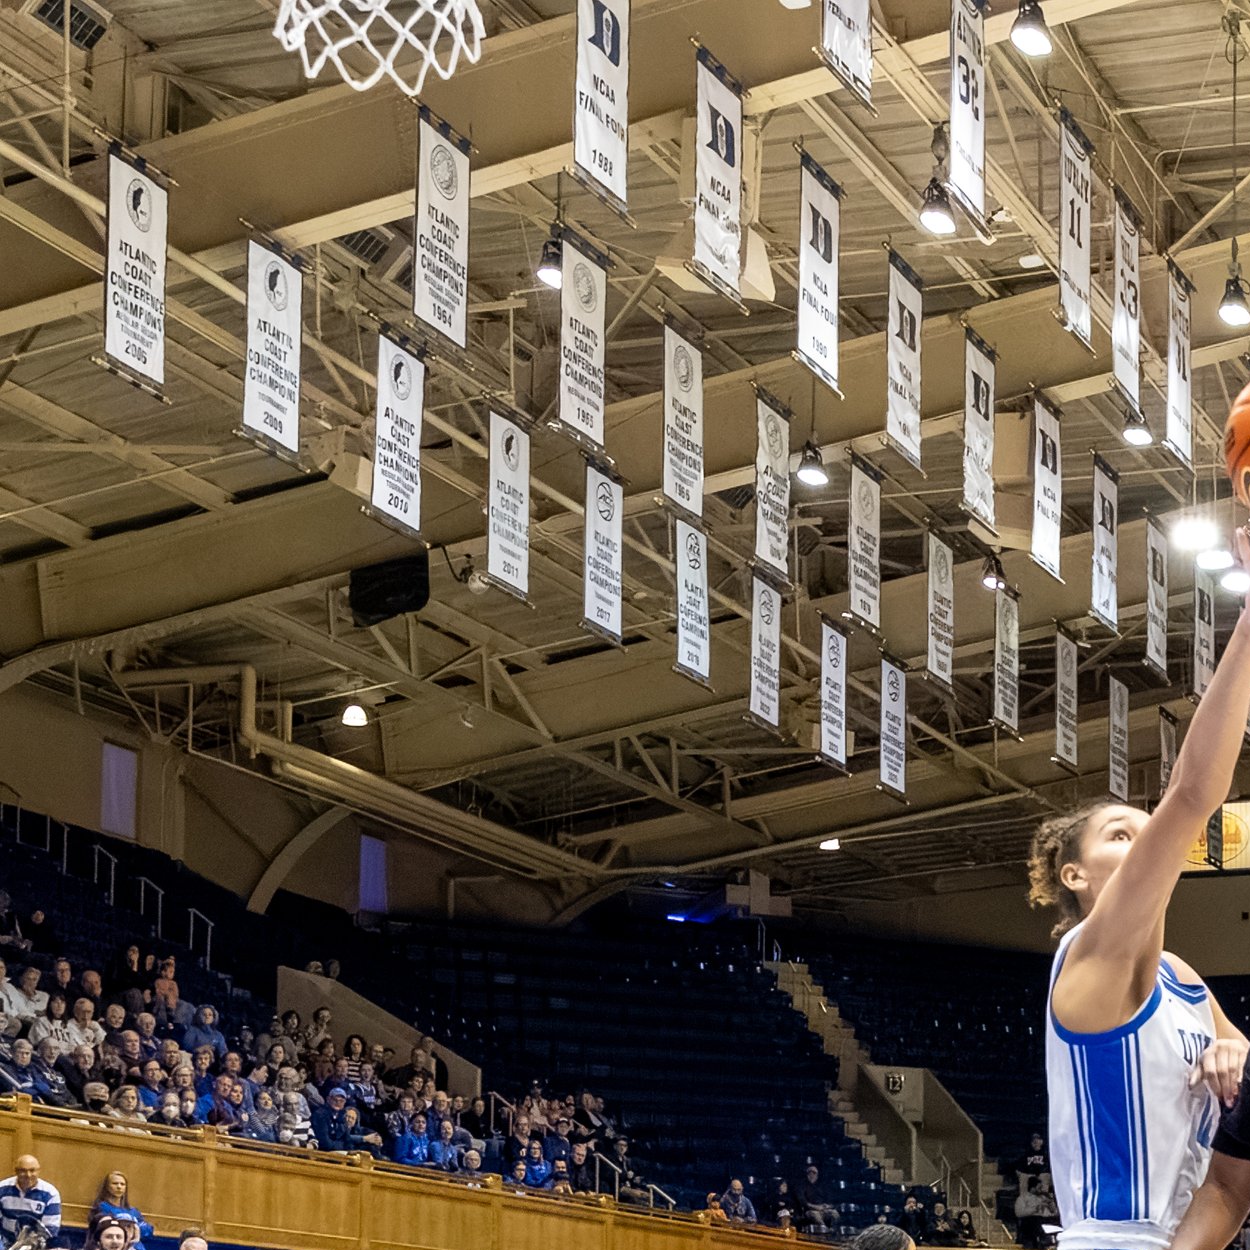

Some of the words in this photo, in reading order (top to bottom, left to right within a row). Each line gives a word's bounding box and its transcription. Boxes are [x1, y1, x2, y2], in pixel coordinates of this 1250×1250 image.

[593, 74, 616, 105] NCAA
[579, 91, 603, 123] FINAL
[592, 149, 613, 177] 1988
[710, 176, 731, 204] NCAA
[428, 203, 460, 239] ATLANTIC
[431, 225, 455, 252] COAST
[119, 240, 157, 275] ATLANTIC
[419, 234, 466, 280] CONFERENCE
[124, 261, 151, 289] COAST
[421, 254, 464, 297] CHAMPIONS
[110, 271, 164, 316] CONFERENCE
[112, 291, 162, 332] CHAMPIONS
[433, 303, 452, 327] 1964
[257, 318, 293, 350] ATLANTIC
[570, 317, 598, 347] ATLANTIC
[264, 338, 288, 363] COAST
[574, 336, 594, 359] COAST
[812, 336, 828, 359] 1990
[249, 348, 298, 388] CONFERENCE
[563, 346, 604, 383] CONFERENCE
[249, 367, 296, 404] CHAMPIONS
[565, 363, 602, 399] CHAMPIONS
[263, 411, 283, 434] 2009
[384, 407, 415, 436] ATLANTIC
[577, 407, 594, 429] 1965
[388, 493, 409, 514] 2010
[503, 561, 519, 579] 2011
[596, 606, 611, 623] 2017
